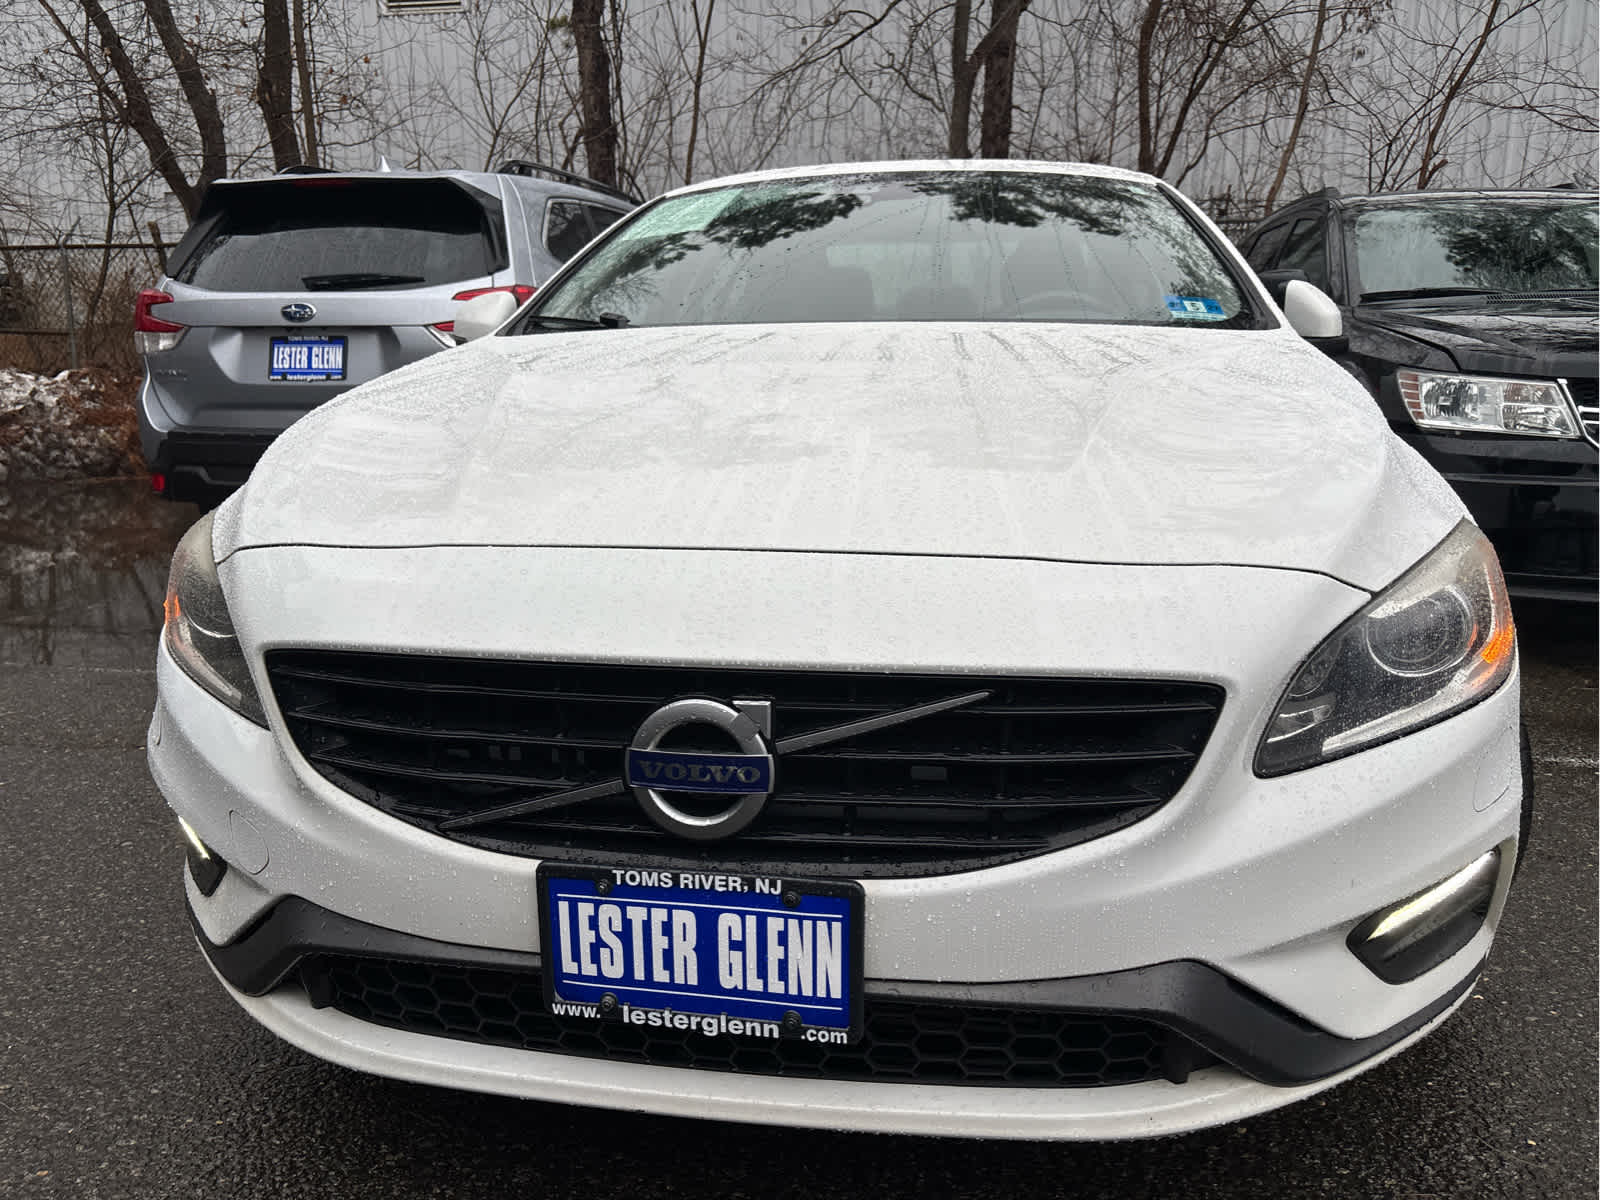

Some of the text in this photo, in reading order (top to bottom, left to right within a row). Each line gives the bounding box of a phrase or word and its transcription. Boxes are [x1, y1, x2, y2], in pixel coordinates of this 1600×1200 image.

[273, 346, 343, 369] LESTER GLENN
[637, 759, 761, 784] VOLVO
[612, 869, 782, 895] TOMS RIVER, NJ
[558, 901, 842, 999] LESTER GLENN
[551, 1002, 848, 1045] www. lesterglenn .com
